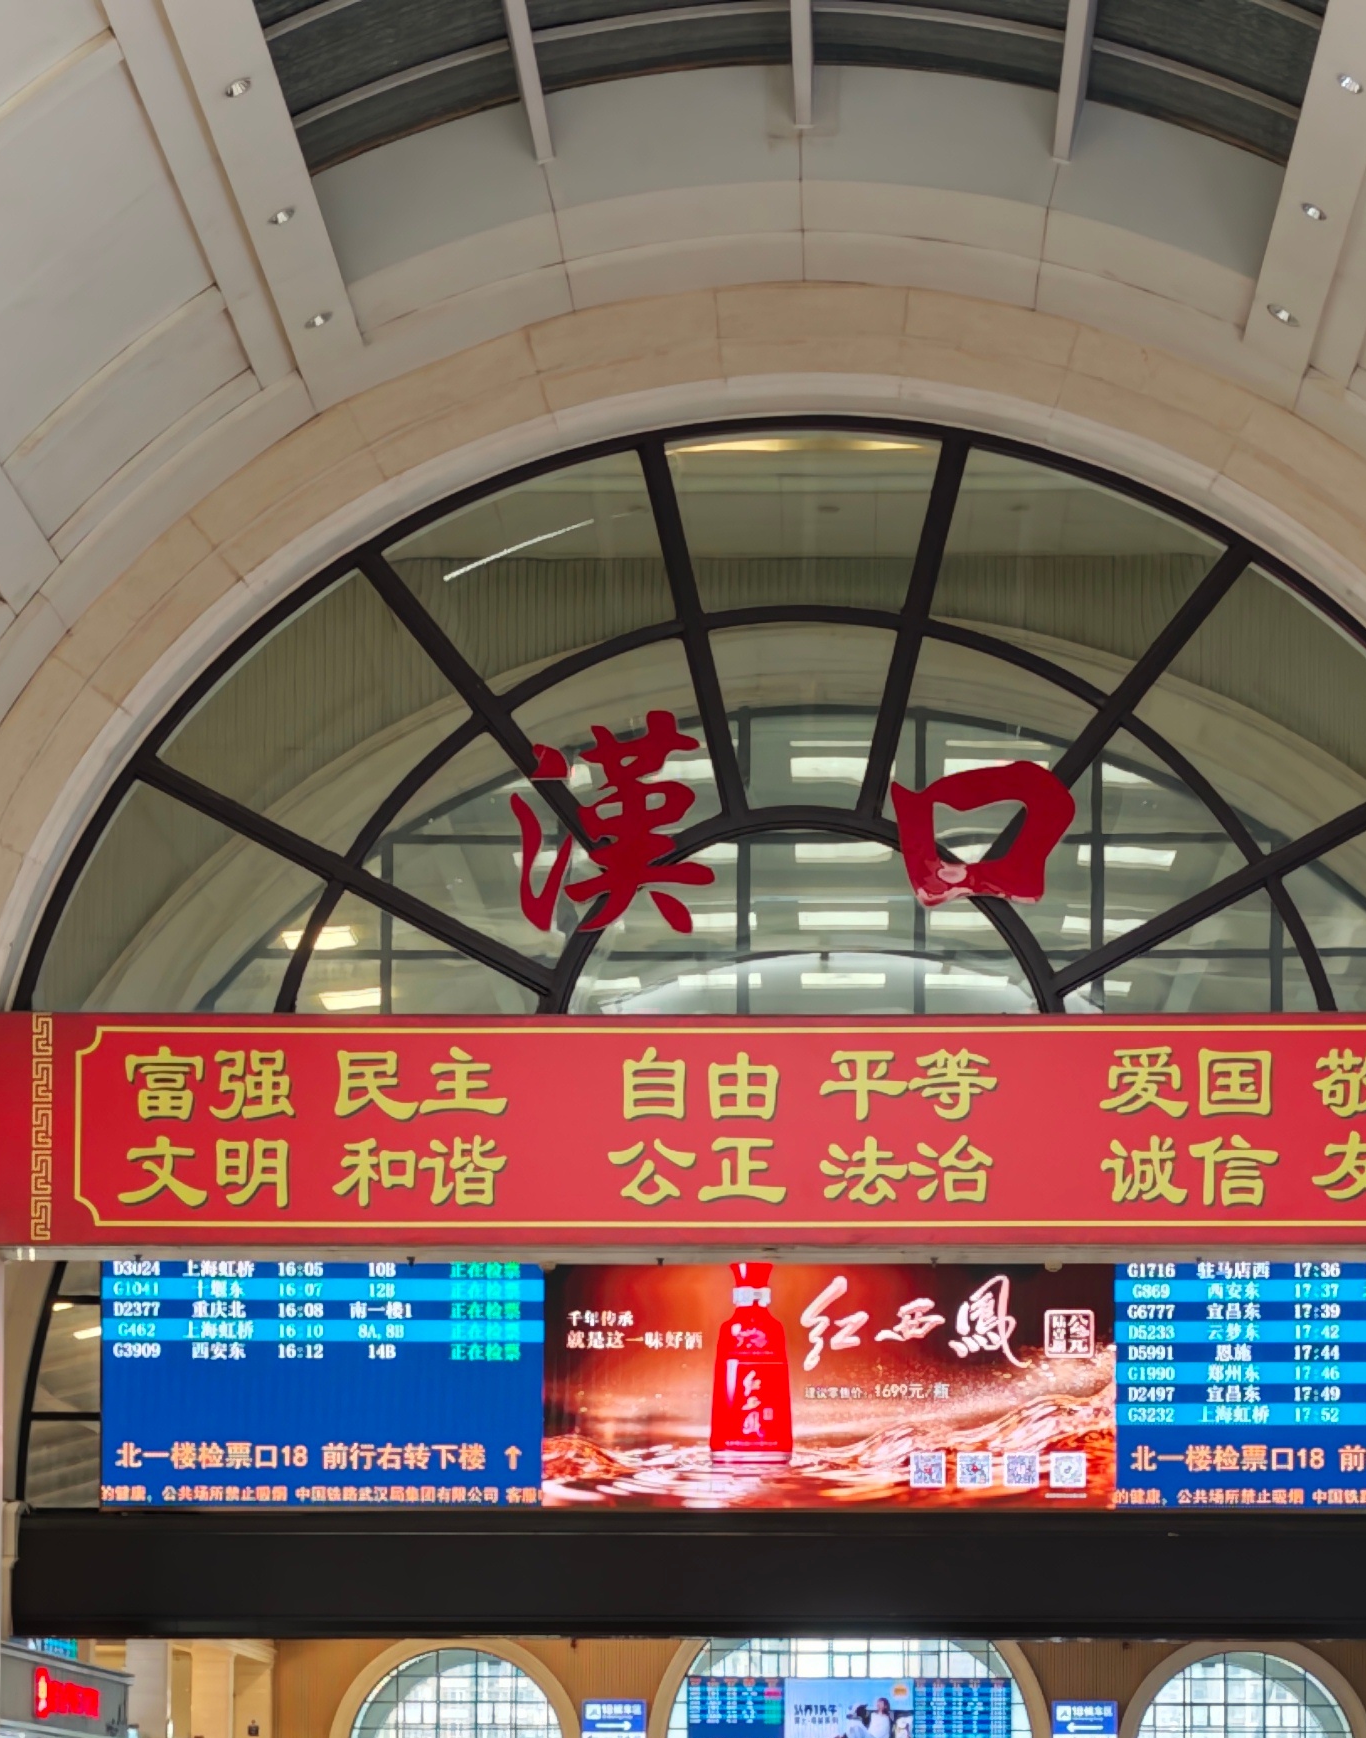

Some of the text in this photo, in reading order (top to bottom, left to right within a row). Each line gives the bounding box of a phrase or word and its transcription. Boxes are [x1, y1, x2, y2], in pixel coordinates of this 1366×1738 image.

[125, 1046, 294, 1121] 富强
[335, 1046, 508, 1121] 民主
[623, 1047, 780, 1120] 自由
[819, 1048, 997, 1121] 平等
[1099, 1046, 1273, 1118] 爱国
[118, 1136, 290, 1208] 文明
[333, 1136, 508, 1207] 和谐
[608, 1137, 787, 1206] 公正
[820, 1135, 993, 1205] 法治
[1101, 1134, 1278, 1206] 诚信
[182, 1260, 255, 1278] 上海虹桥
[278, 1260, 324, 1278] 16:05
[368, 1260, 396, 1278] 10B
[1127, 1261, 1176, 1279] G1716
[1197, 1261, 1270, 1279] 驻马店西
[1294, 1261, 1341, 1279] 17:36
[113, 1280, 160, 1299] G1041
[278, 1280, 324, 1299] 16:07
[368, 1280, 396, 1299] 12B
[1132, 1282, 1171, 1300] G869
[1207, 1282, 1260, 1300] 西安东
[1294, 1282, 1341, 1300] 17:37
[113, 1301, 160, 1319] D2377
[191, 1301, 246, 1319] 重庆北
[278, 1301, 324, 1319] 16:08
[566, 1310, 634, 1327] 千年传承
[1127, 1303, 1176, 1320] G6777
[1206, 1303, 1261, 1320] 宜昌东
[1294, 1303, 1341, 1320] 17:39
[118, 1321, 156, 1340] G462
[182, 1321, 254, 1340] 上海虹桥
[278, 1321, 324, 1340] 16:10
[1207, 1323, 1260, 1341] 云梦东
[1294, 1323, 1341, 1341] 17:42
[566, 1330, 703, 1350] 就是这一味好酒
[113, 1342, 160, 1360] G3909
[191, 1342, 246, 1360] 西安东
[278, 1342, 324, 1360] 16:12
[368, 1342, 396, 1360] 14B
[1127, 1344, 1176, 1361] D5991
[1215, 1344, 1252, 1361] 恩施
[1294, 1344, 1341, 1361] 17:44
[1127, 1364, 1176, 1382] G1990
[1207, 1364, 1260, 1382] 郑州东
[1294, 1364, 1341, 1382] 17:46
[1127, 1385, 1176, 1403] D2497
[1206, 1385, 1261, 1403] 宜昌东
[1294, 1385, 1341, 1403] 17:49
[1127, 1405, 1176, 1423] G3232
[1198, 1405, 1270, 1423] 上海虹桥
[1294, 1405, 1341, 1423] 17:52
[115, 1442, 486, 1470] 北一楼检票口18 前行右转下楼
[1131, 1444, 1325, 1472] 北一楼检票口18
